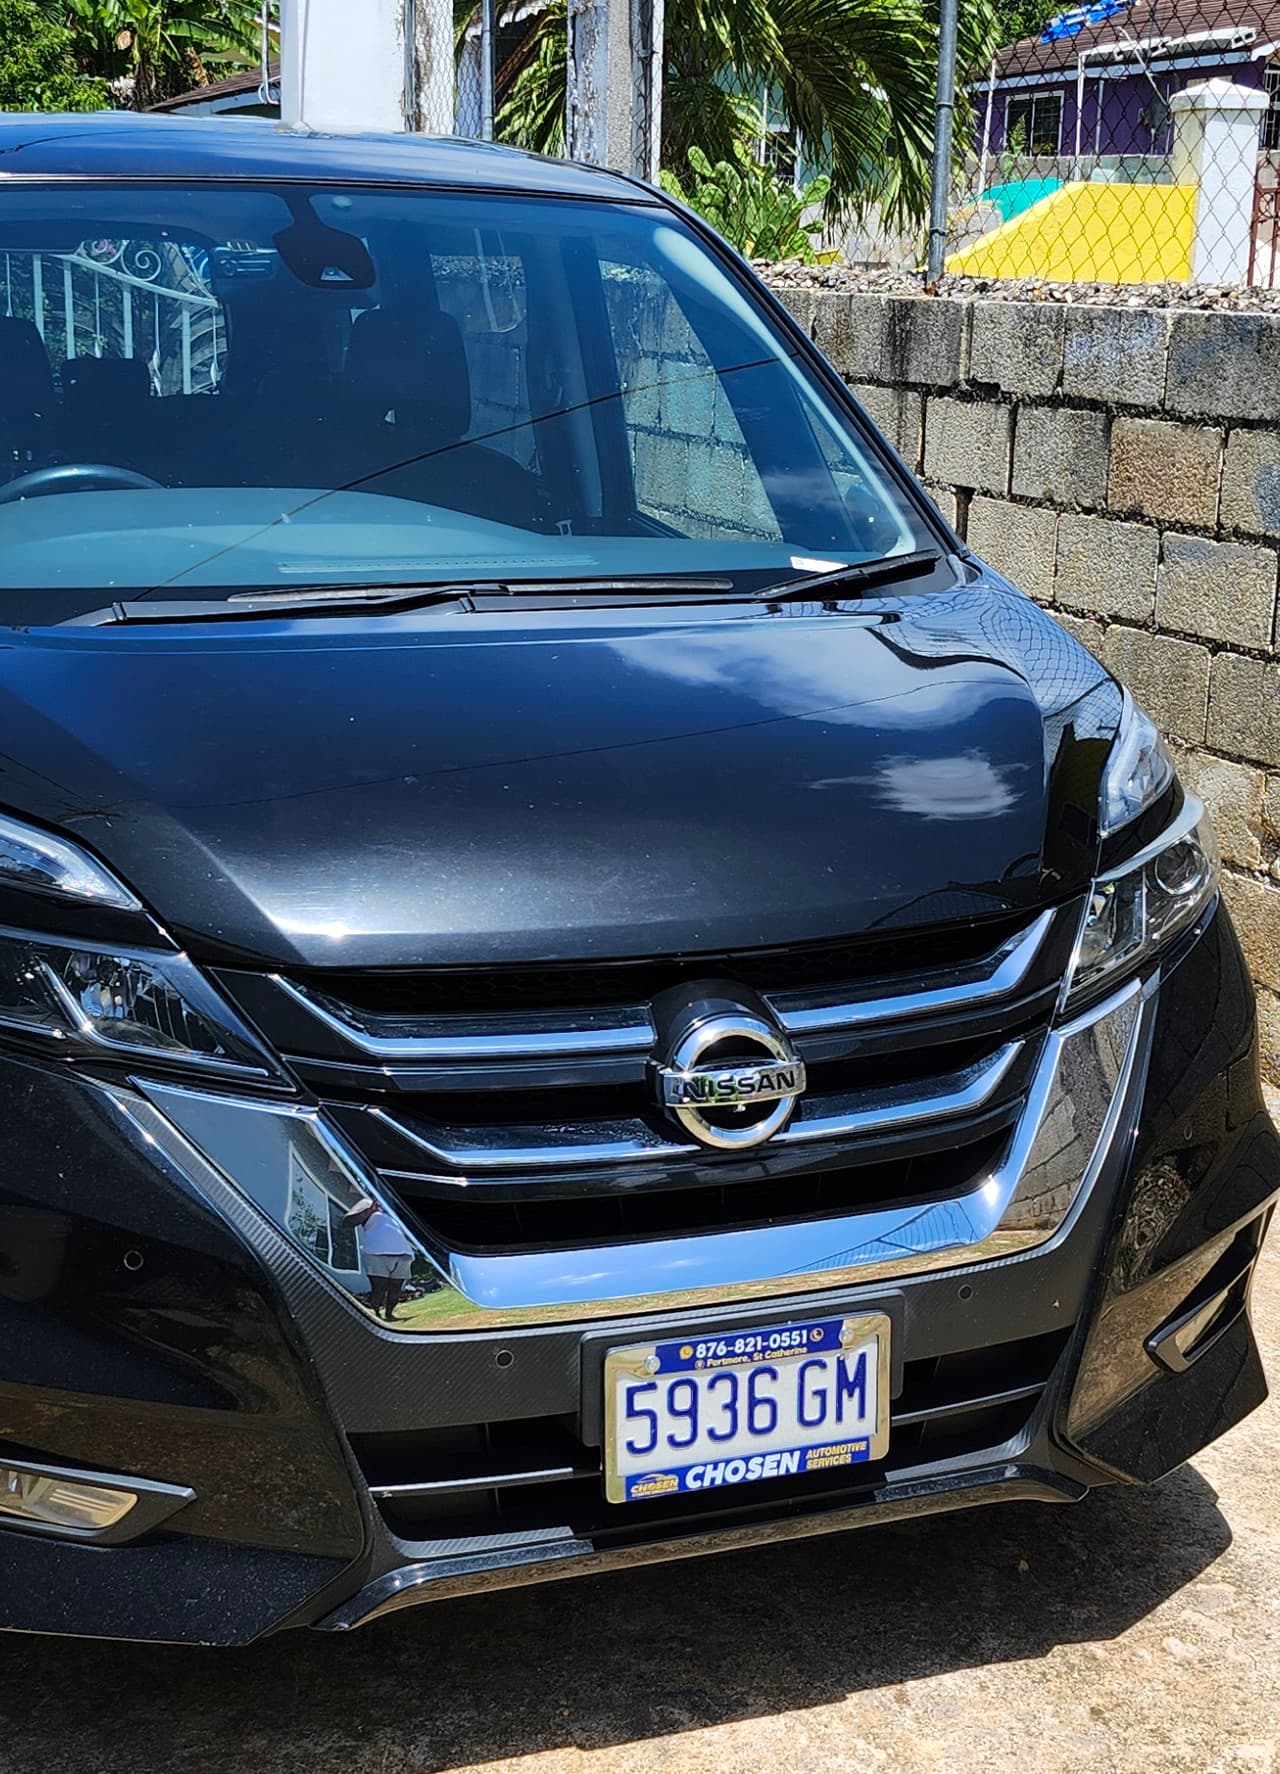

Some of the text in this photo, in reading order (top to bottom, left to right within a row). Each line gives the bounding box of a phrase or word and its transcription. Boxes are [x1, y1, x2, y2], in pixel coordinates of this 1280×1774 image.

[683, 1069, 795, 1099] NISSAN
[695, 1329, 808, 1358] 876-821-0551
[706, 1347, 808, 1367] Portmore, St Catherine
[625, 1351, 867, 1455] 5936 GM
[805, 1441, 867, 1459] AUTOMOTIVE
[806, 1453, 852, 1470] SERVICES
[685, 1450, 801, 1489] CHOSEN
[631, 1479, 678, 1493] CHOSEN
